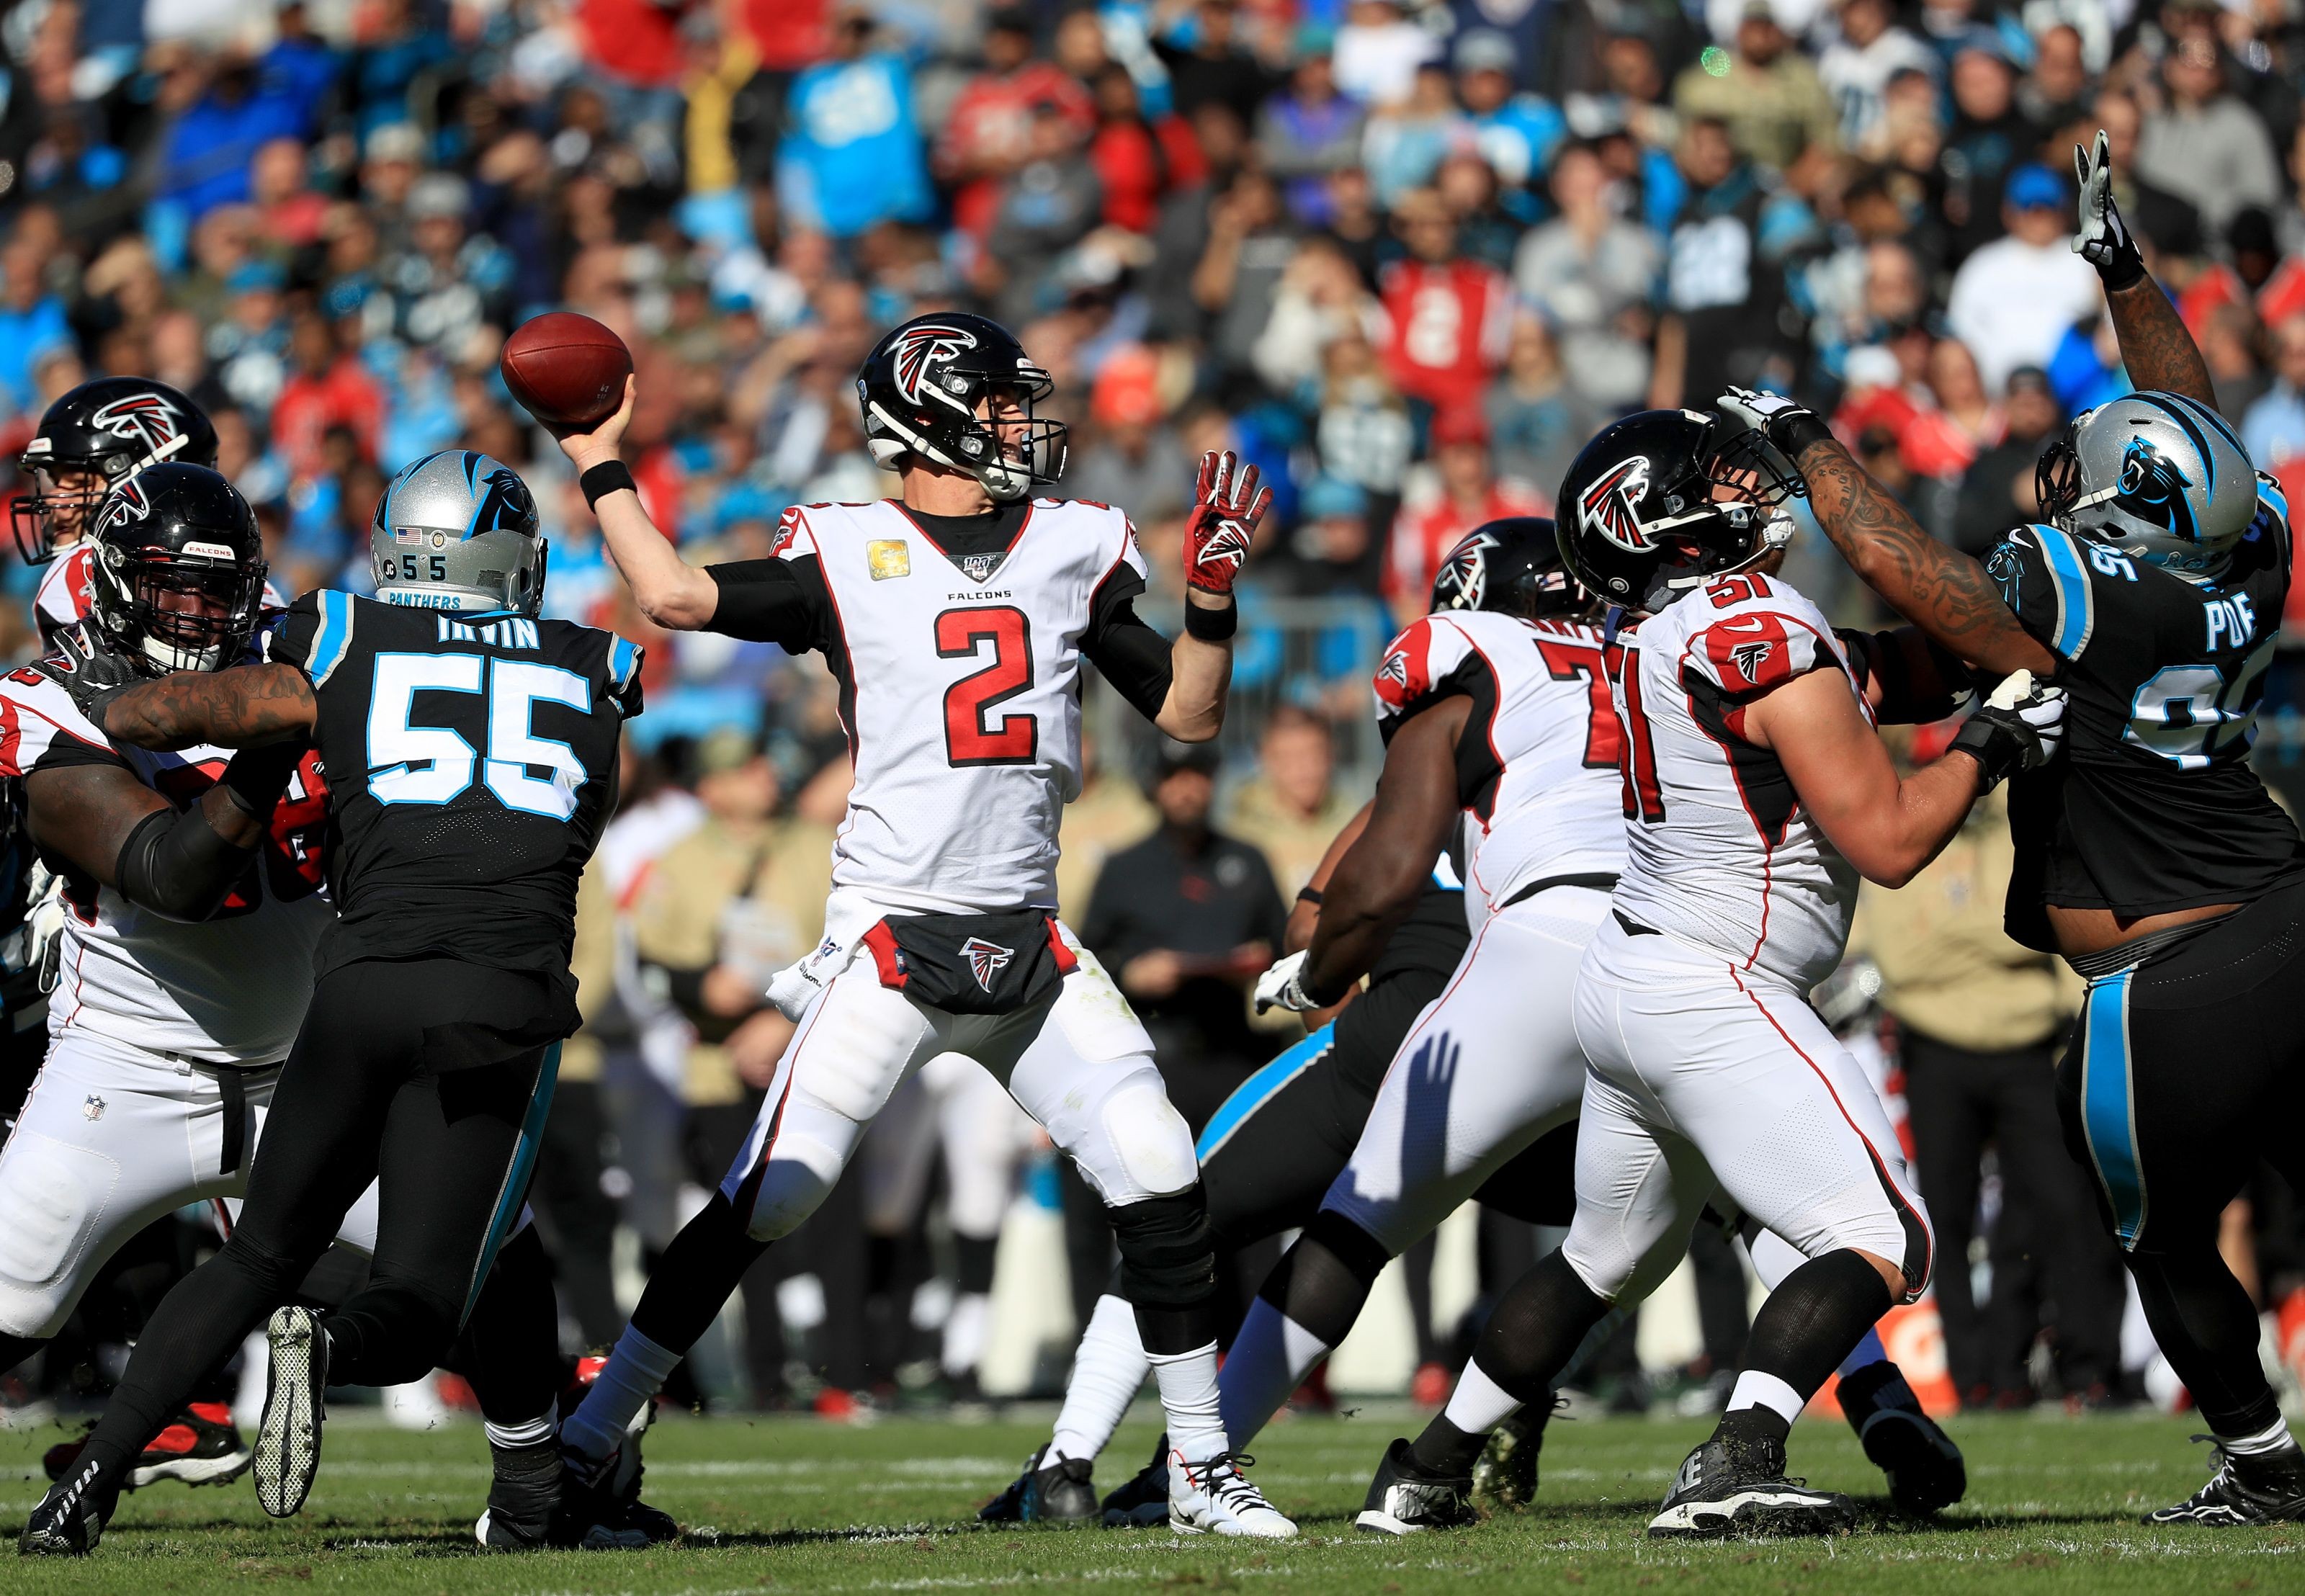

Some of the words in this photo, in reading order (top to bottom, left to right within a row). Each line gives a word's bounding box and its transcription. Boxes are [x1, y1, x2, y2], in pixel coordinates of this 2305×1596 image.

[189, 547, 231, 557] FALCONS
[385, 563, 395, 576] JC
[402, 554, 446, 580] 55
[389, 592, 461, 610] PANTHERS
[947, 591, 1012, 601] FALCONS
[437, 613, 540, 650] IRVIN
[2203, 591, 2257, 653] POE
[934, 605, 1037, 768] 2
[367, 652, 591, 822] 55
